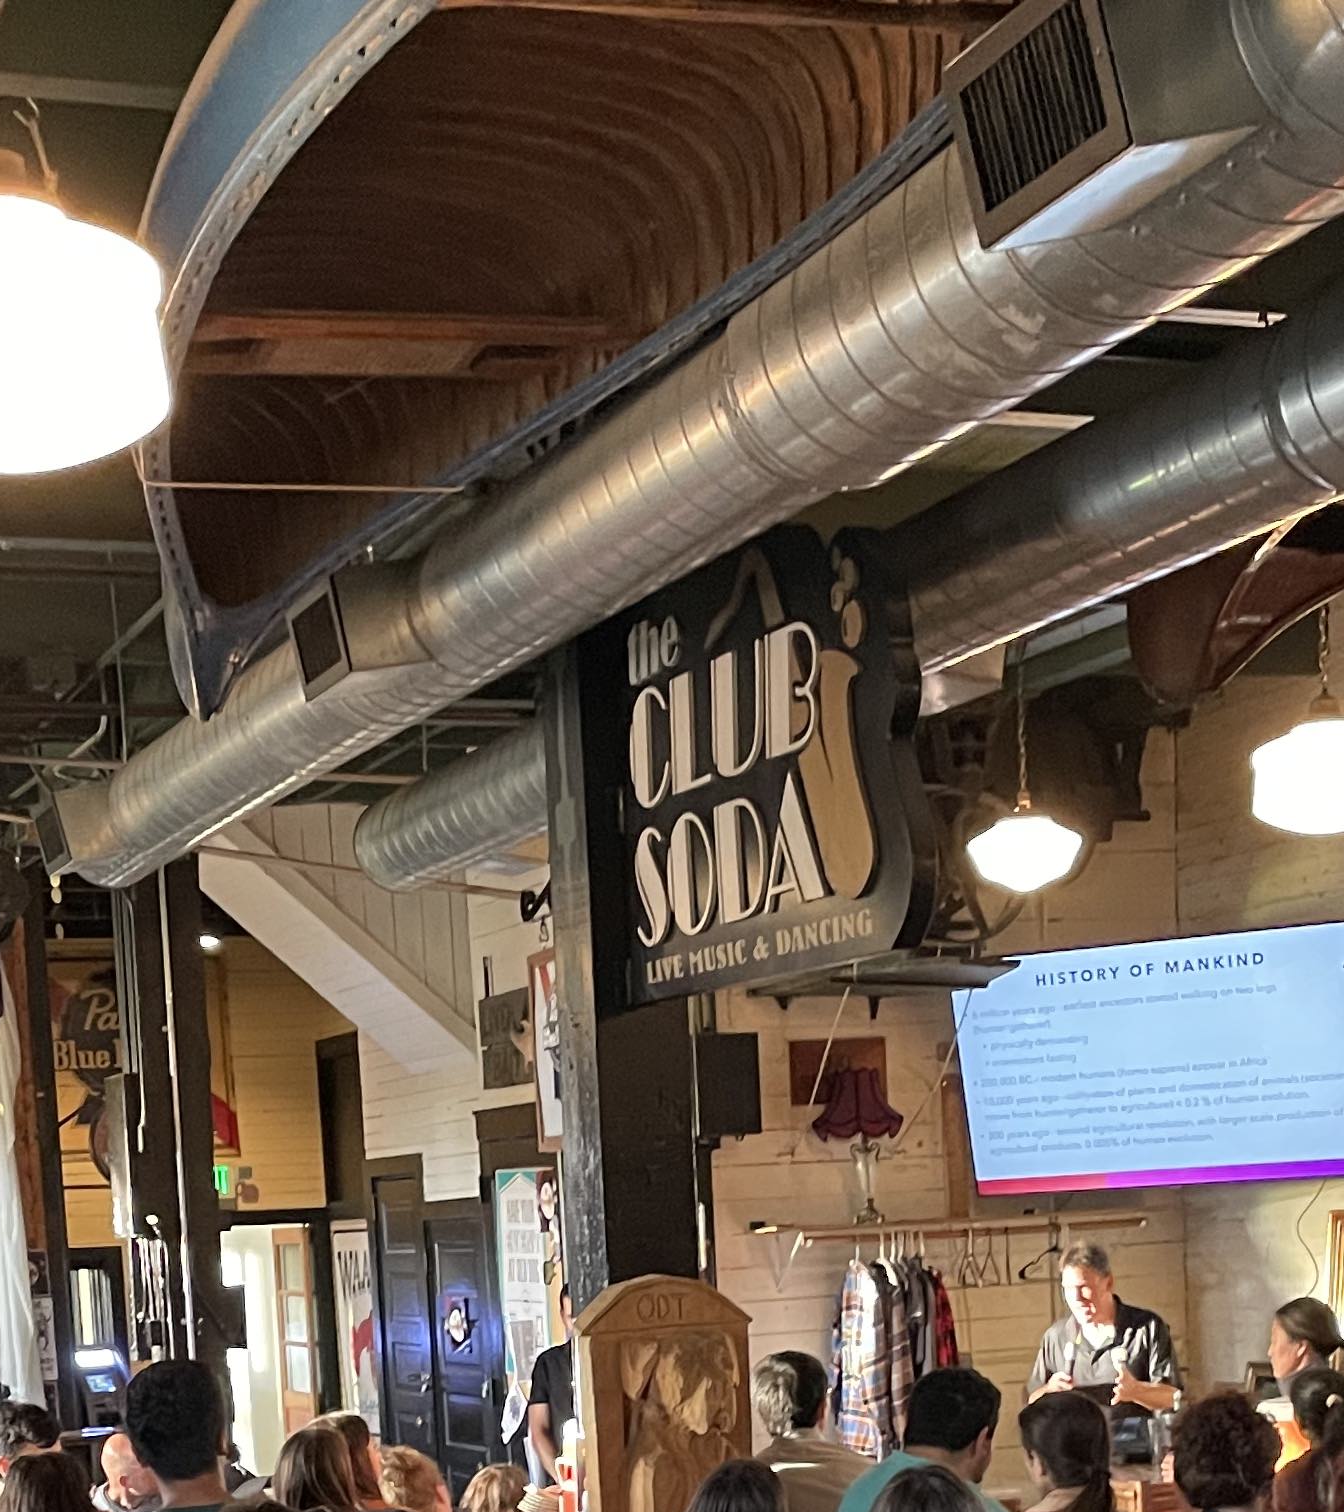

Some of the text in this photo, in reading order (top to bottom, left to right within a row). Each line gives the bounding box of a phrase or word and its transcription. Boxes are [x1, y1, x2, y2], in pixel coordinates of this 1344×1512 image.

[628, 615, 680, 686] the
[630, 621, 819, 809] CLUB
[635, 768, 826, 948] SODA
[647, 909, 873, 984] LIVE MUSIC & DANCING
[1035, 952, 1265, 987] HISTORY OF MANKIND
[54, 1039, 111, 1070] Blue
